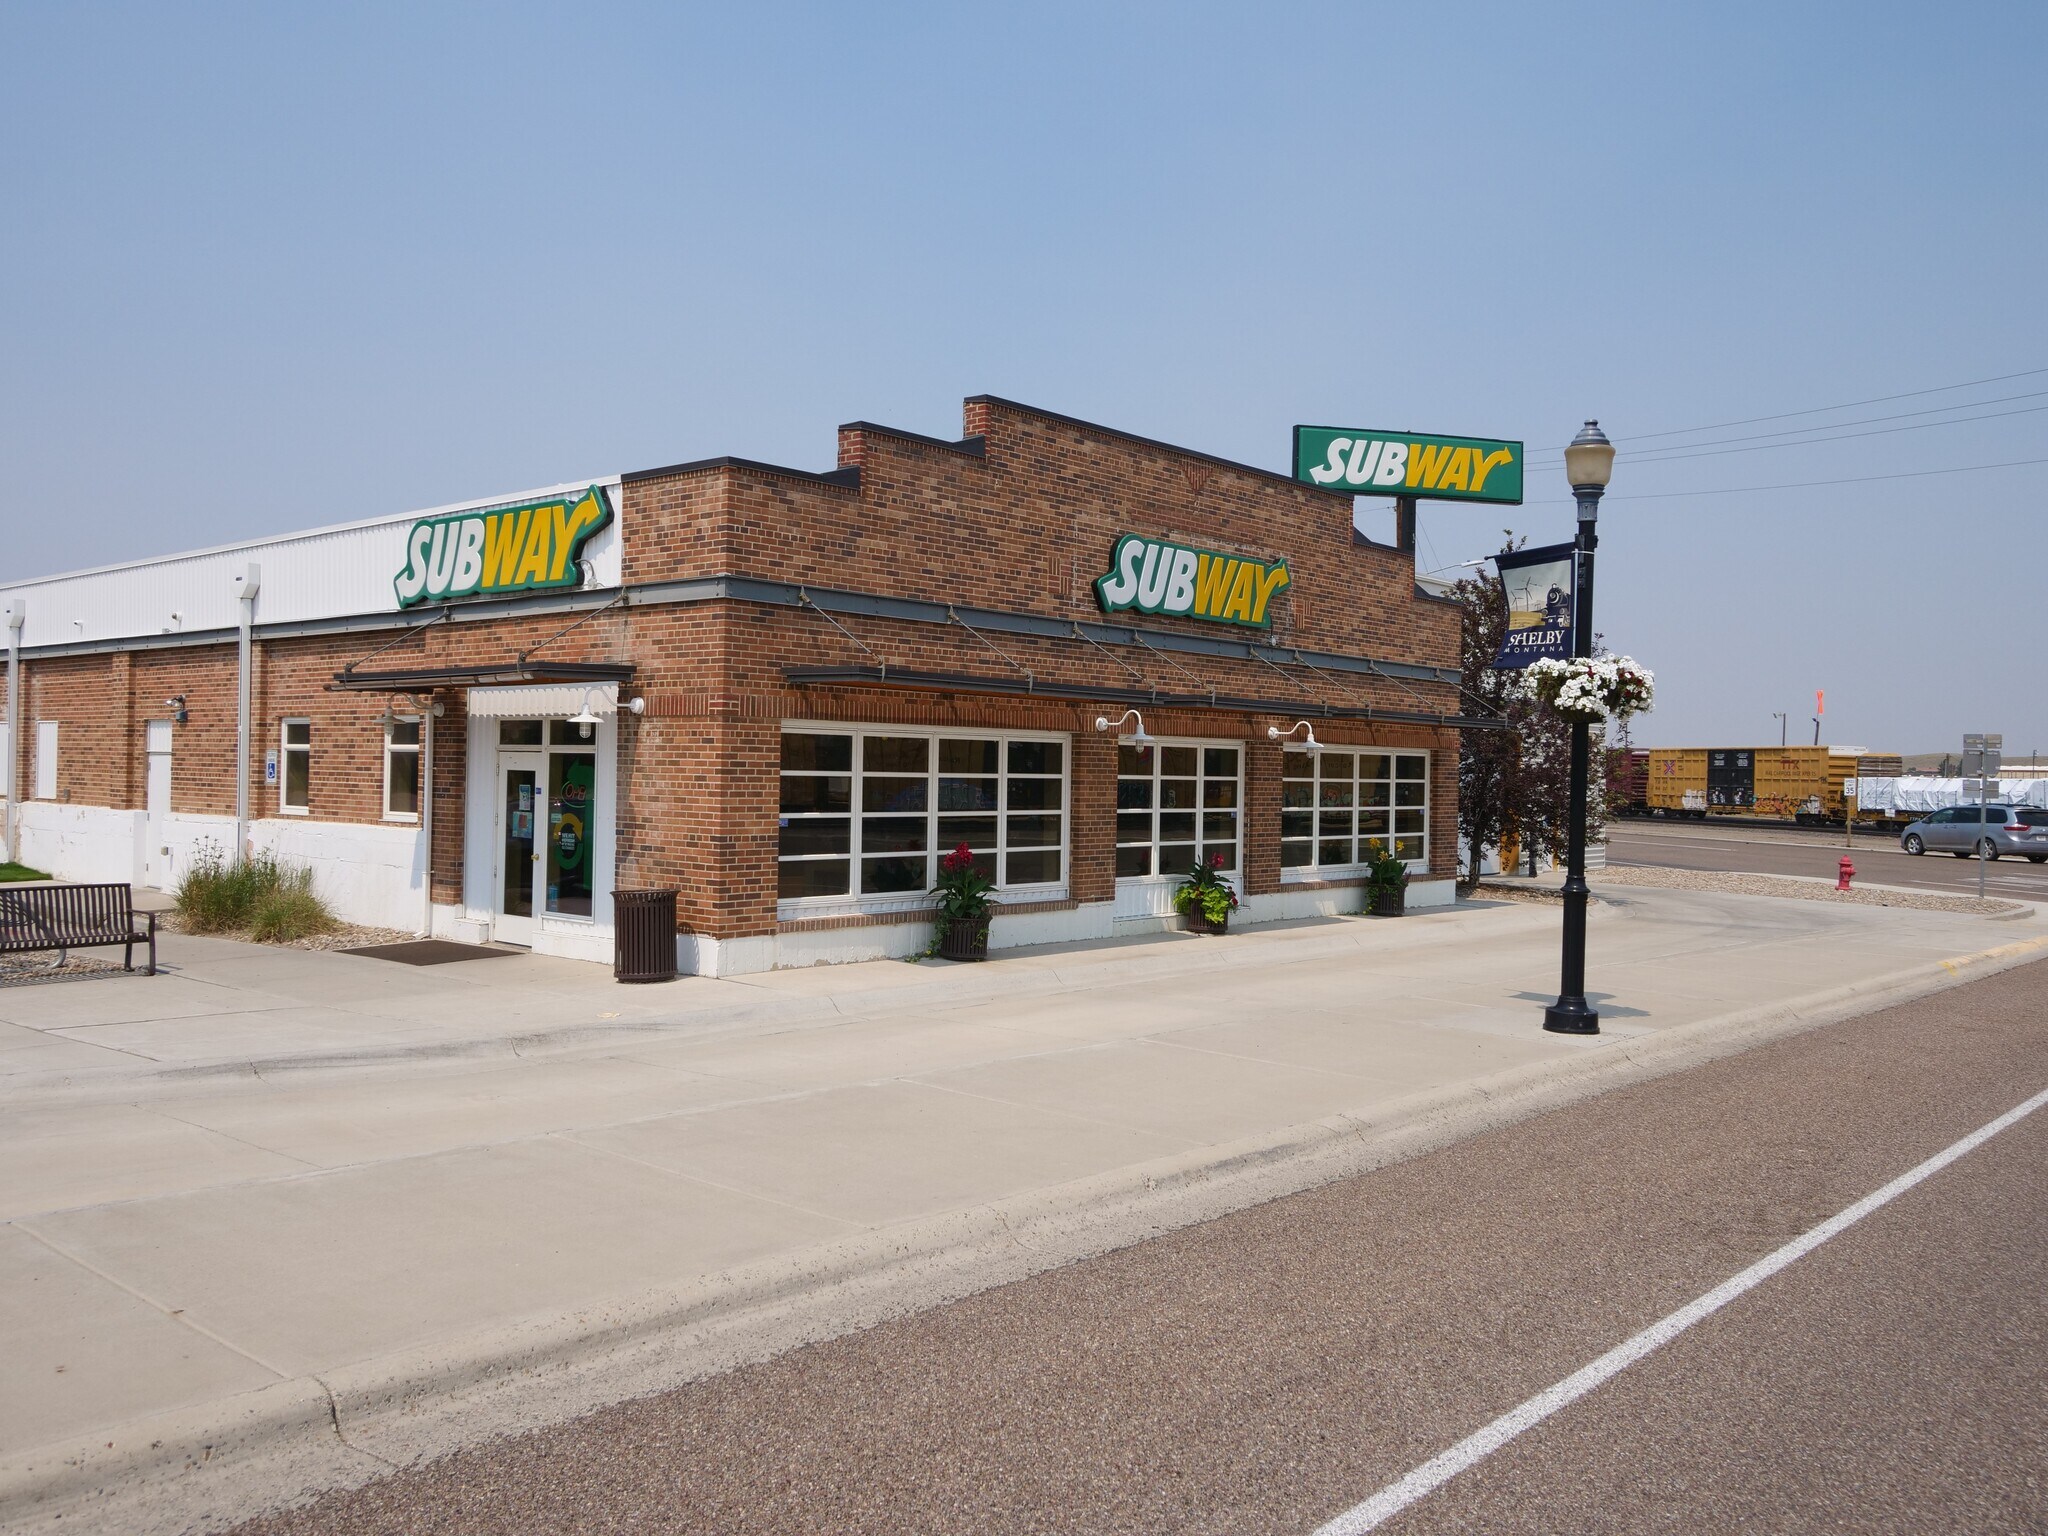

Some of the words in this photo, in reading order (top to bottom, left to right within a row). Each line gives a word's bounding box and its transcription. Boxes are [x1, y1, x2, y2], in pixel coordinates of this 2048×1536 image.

[1309, 437, 1514, 493] SUBWAY
[395, 491, 600, 602] SUBWAY
[1103, 539, 1290, 624] SUBWAY
[1508, 630, 1565, 647] SHELBY
[1845, 787, 1854, 795] 35
